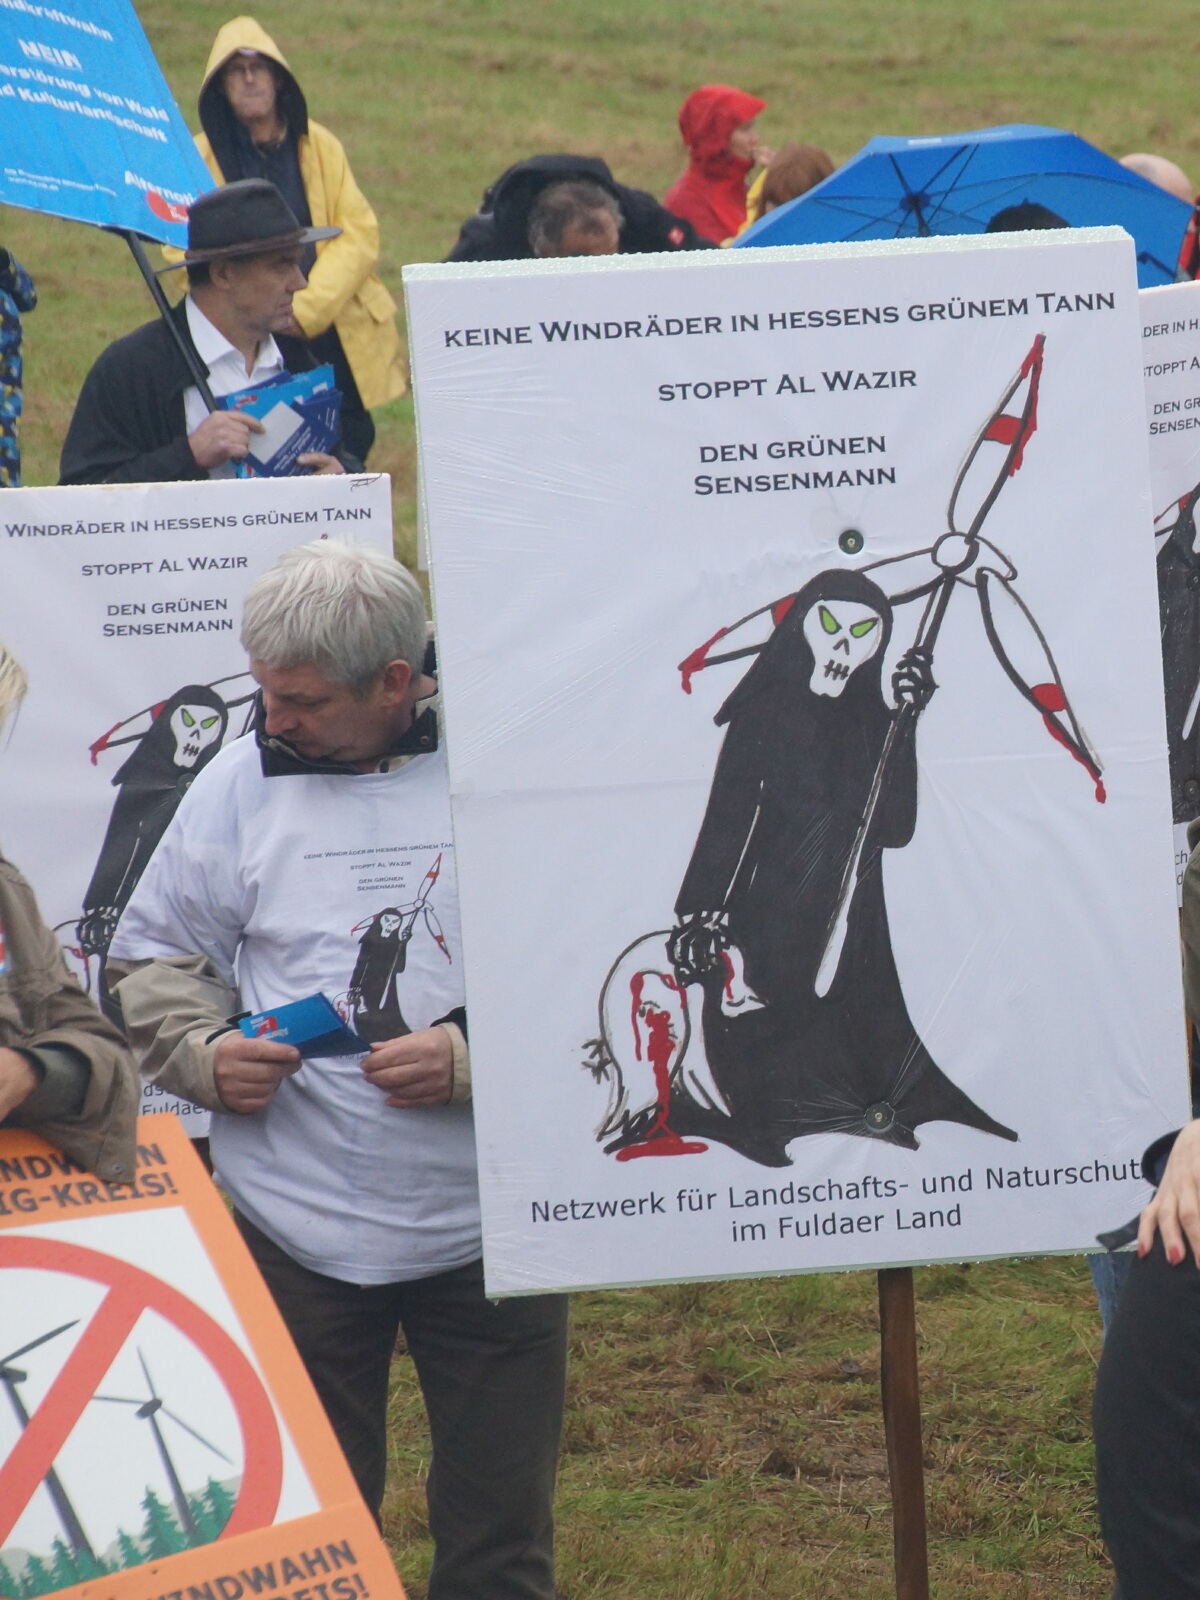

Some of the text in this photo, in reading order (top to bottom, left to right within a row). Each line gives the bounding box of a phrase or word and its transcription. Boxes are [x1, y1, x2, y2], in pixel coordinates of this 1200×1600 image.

[18, 38, 83, 71] NEIN
[93, 87, 124, 107] von
[124, 97, 170, 122] Wald
[444, 291, 1116, 348] KEINE WINDRÄDER IN HESSENS GRÜNEM TANN
[1141, 323, 1169, 339] DER
[1172, 320, 1186, 334] IN
[658, 369, 918, 402] STOPPT AL WAZIR
[1153, 399, 1181, 416] DEN
[699, 434, 887, 464] DEN GRÜNEN
[694, 466, 897, 496] SENSENMANN
[5, 507, 372, 538] WINDRÄDER IN HESSENS GRÜNEM TANN
[81, 556, 249, 577] STOPPT AL WAZIR
[106, 597, 229, 618] DEN GRÜNEN
[102, 618, 234, 638] SENSENMANN
[409, 843, 439, 851] GRÜNEM
[374, 875, 404, 883] GRÜNEN
[530, 1157, 1145, 1224] Netzwerk für Landschafts- und Naturschut
[732, 1203, 962, 1243] im Fuldaer Land
